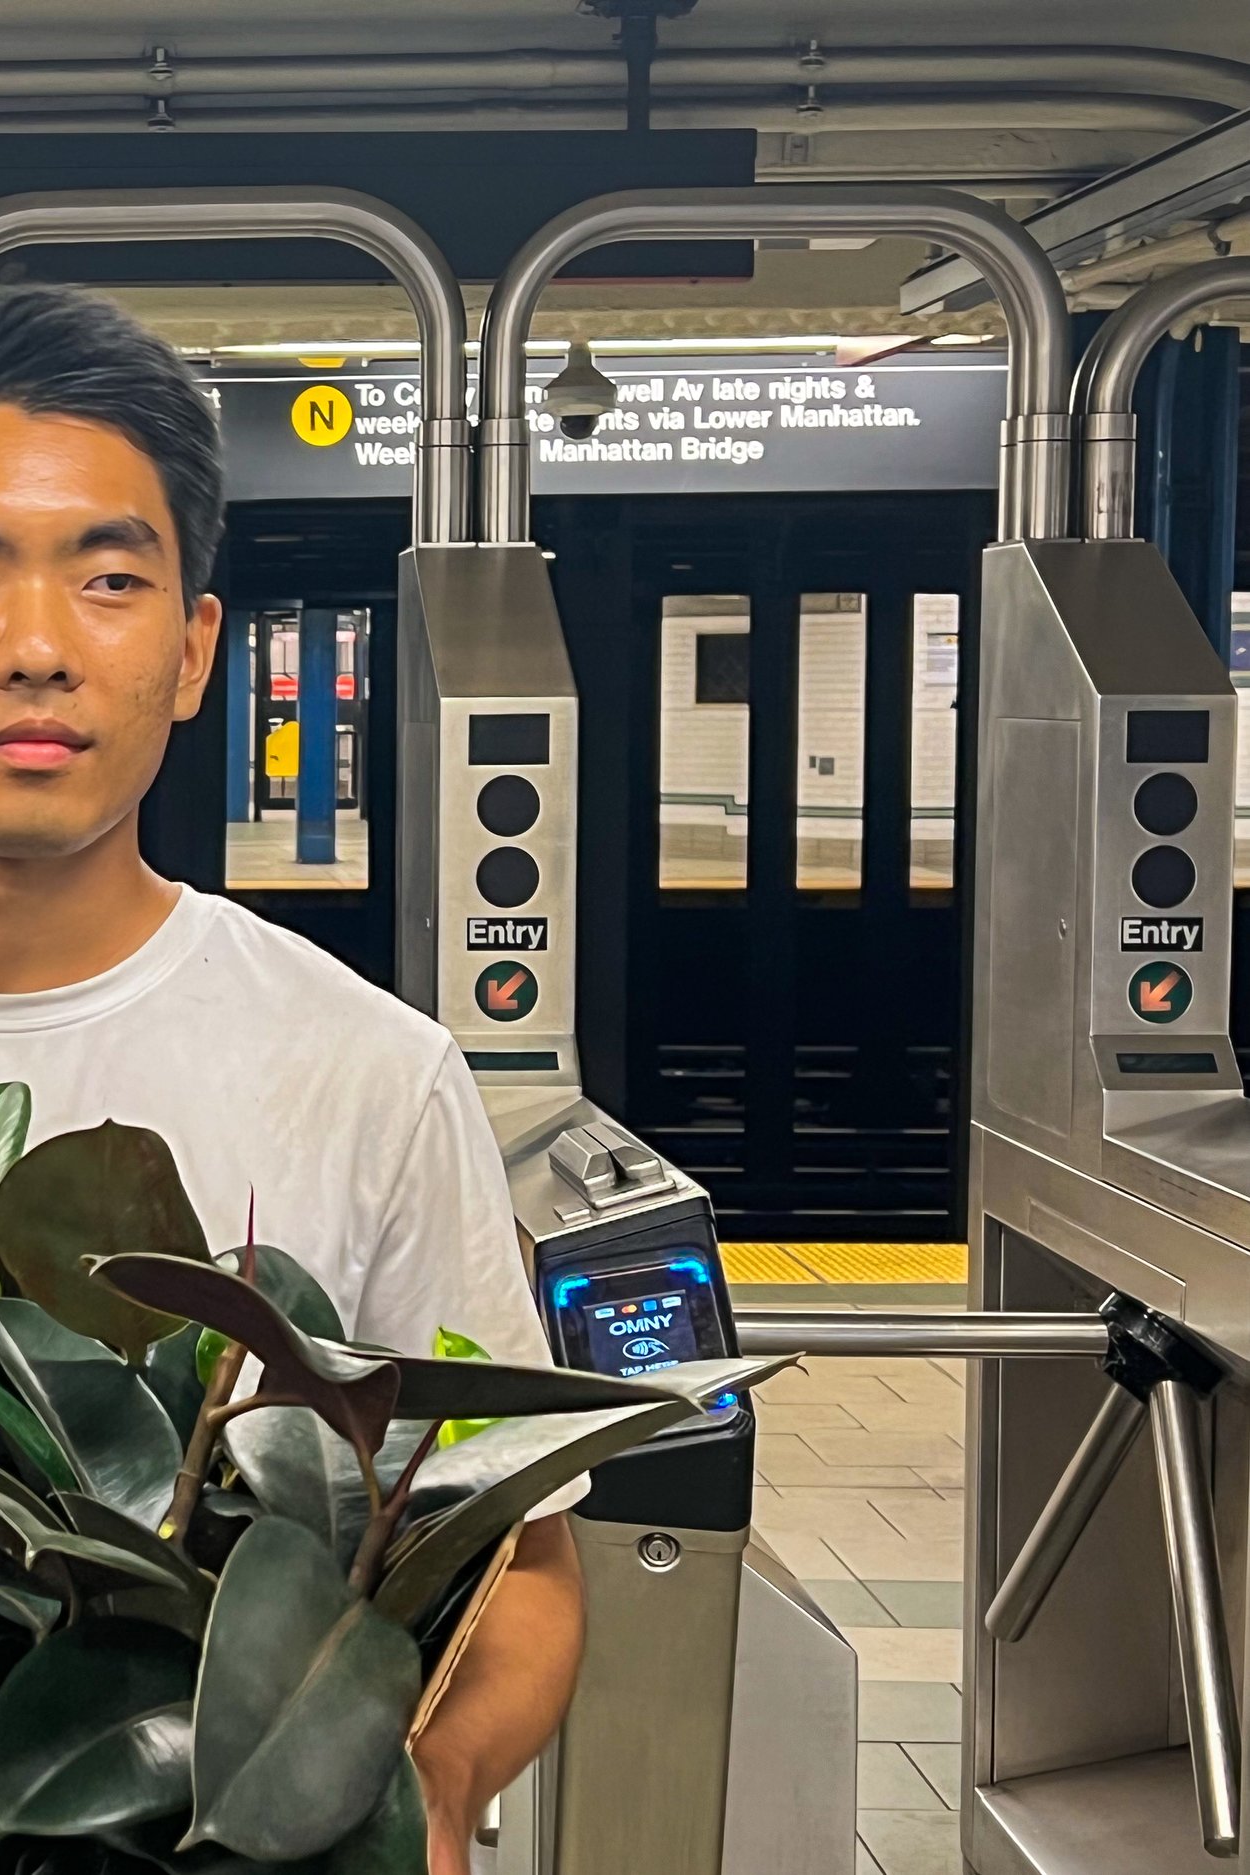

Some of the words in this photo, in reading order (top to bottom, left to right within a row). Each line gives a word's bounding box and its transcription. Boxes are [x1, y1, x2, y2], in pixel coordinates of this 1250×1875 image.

[354, 383, 386, 407] To
[672, 378, 704, 401] Av
[712, 377, 761, 401] late
[768, 376, 847, 404] nights
[854, 374, 876, 399] &
[310, 401, 334, 431] N
[648, 407, 685, 430] via
[693, 406, 773, 430] Lower
[780, 404, 921, 428] Manhattan.
[539, 438, 673, 463] Manhattan
[681, 436, 765, 464] Bridge
[469, 920, 544, 949] Entry
[1123, 920, 1199, 949] Entry
[609, 1313, 673, 1336] OMNY
[620, 1365, 644, 1377] TAP
